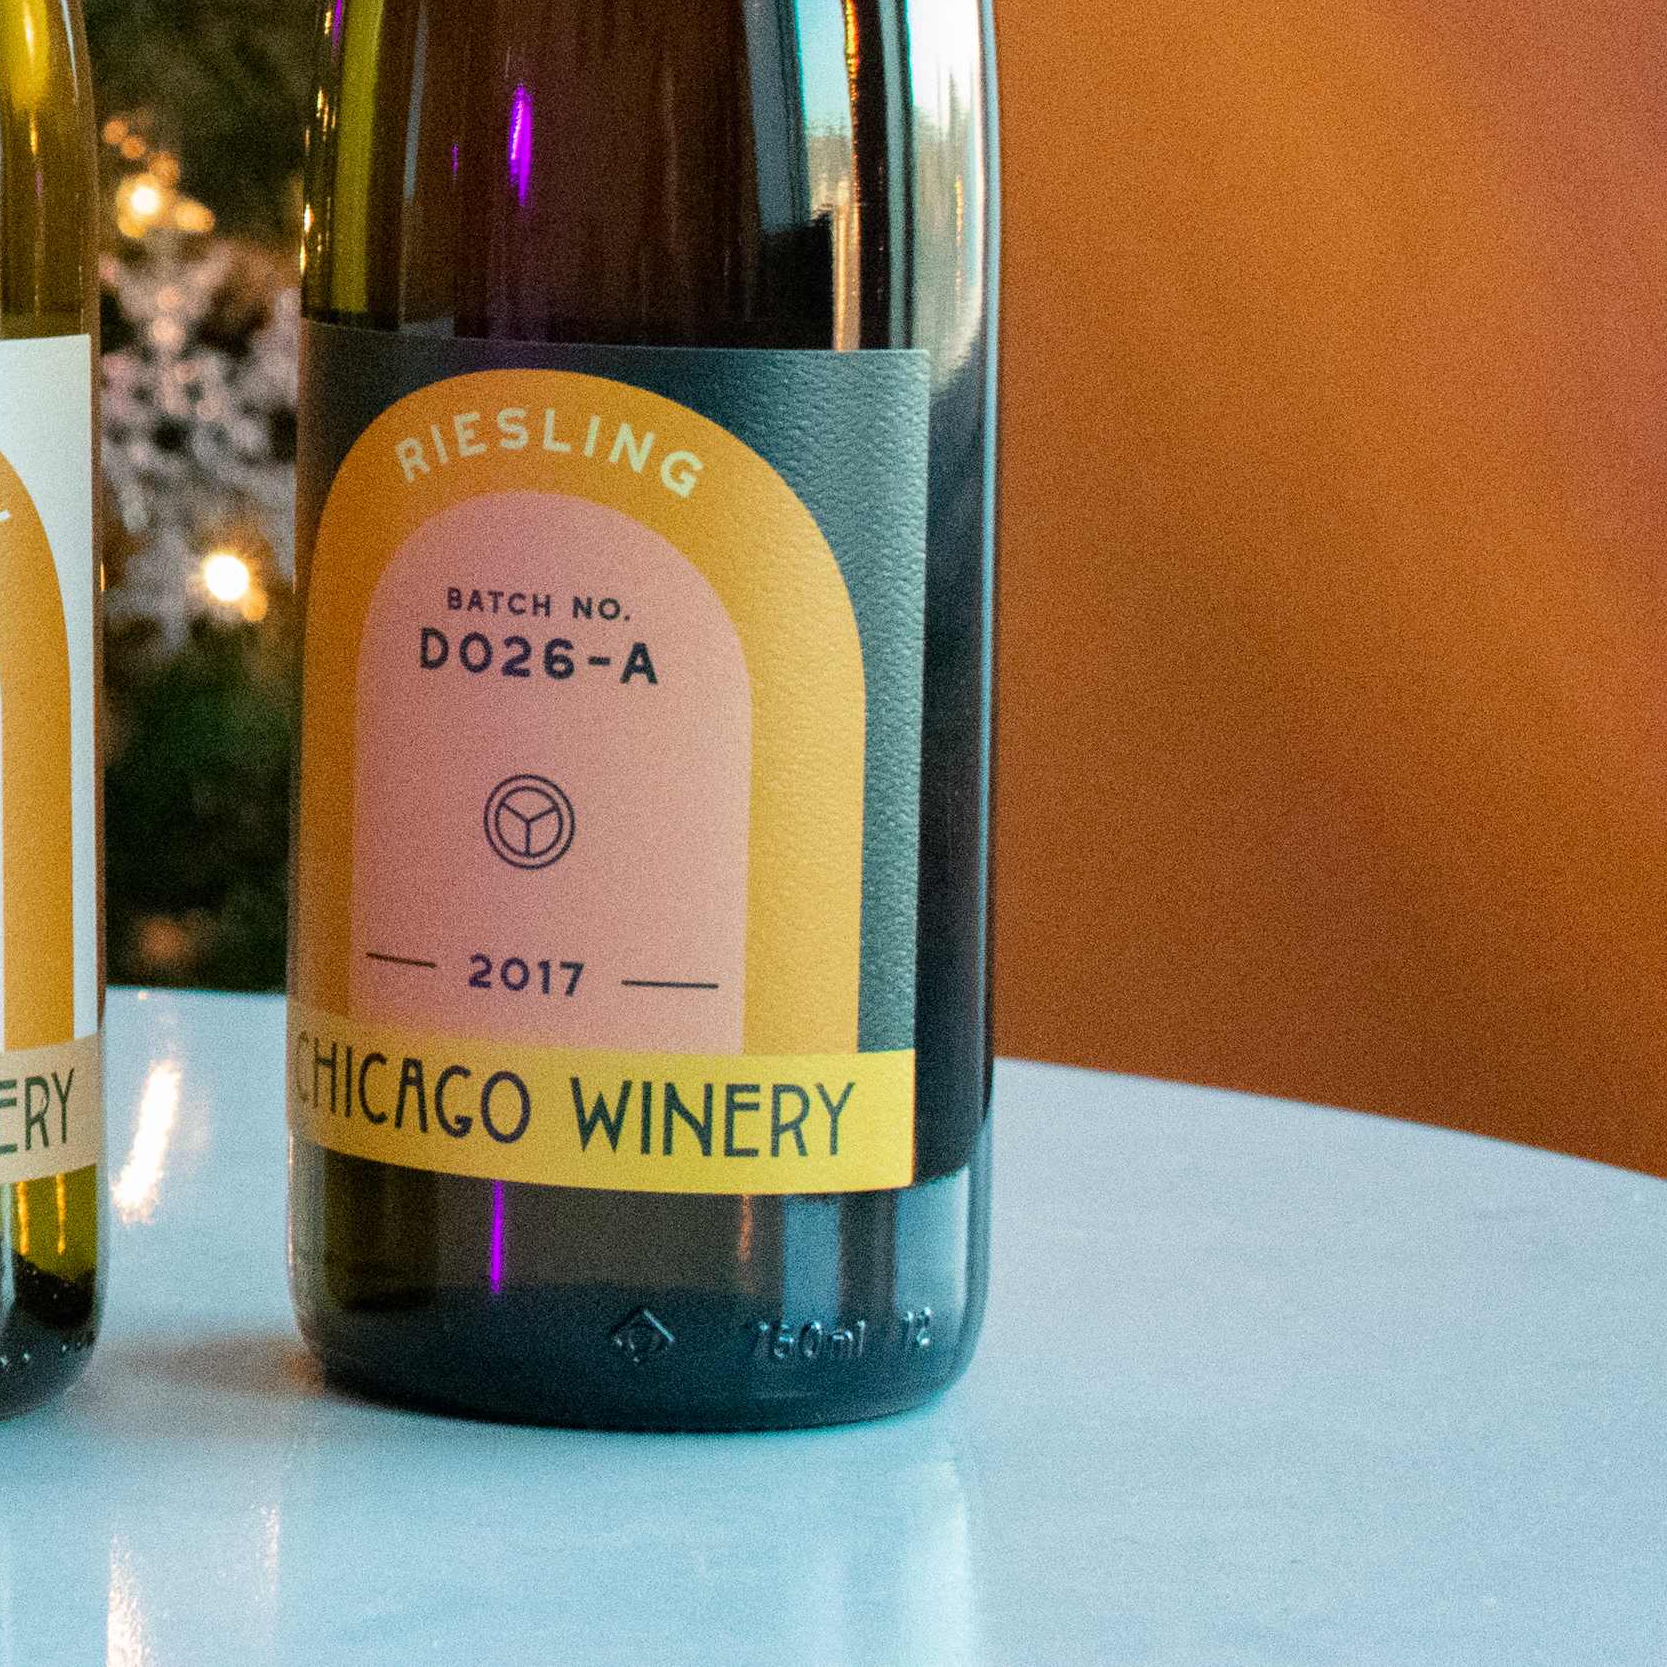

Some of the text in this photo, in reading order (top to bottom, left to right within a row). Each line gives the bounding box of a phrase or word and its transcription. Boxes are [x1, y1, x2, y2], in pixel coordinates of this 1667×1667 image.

[394, 407, 704, 498] RIESLING
[447, 586, 631, 622] BATCH NO.
[419, 627, 659, 686] D026-A
[468, 954, 584, 997] 2017
[296, 1031, 855, 1158] CHICAGO WINERY
